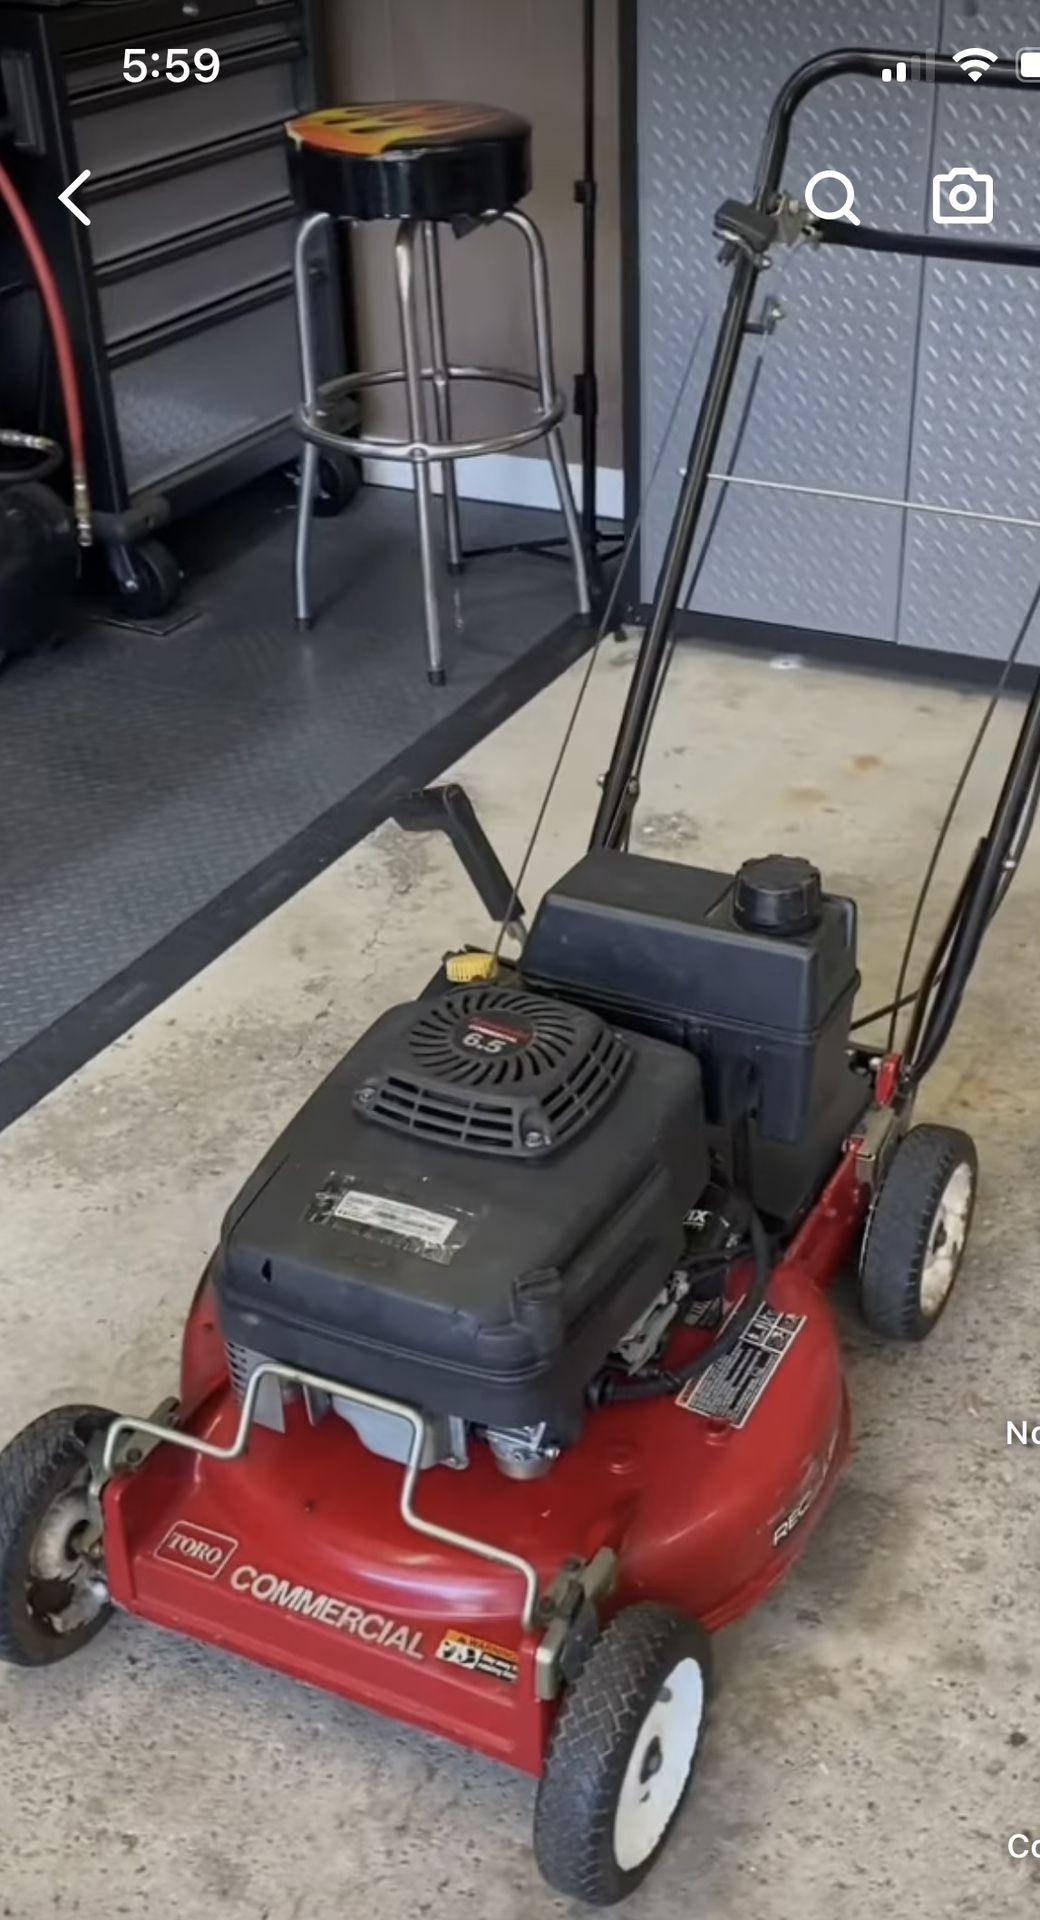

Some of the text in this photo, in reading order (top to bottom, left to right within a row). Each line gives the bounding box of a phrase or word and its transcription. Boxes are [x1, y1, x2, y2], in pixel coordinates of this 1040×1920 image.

[462, 1032, 507, 1054] 6.5
[167, 1531, 223, 1565] TORO
[230, 1564, 425, 1660] COMMERCIAL
